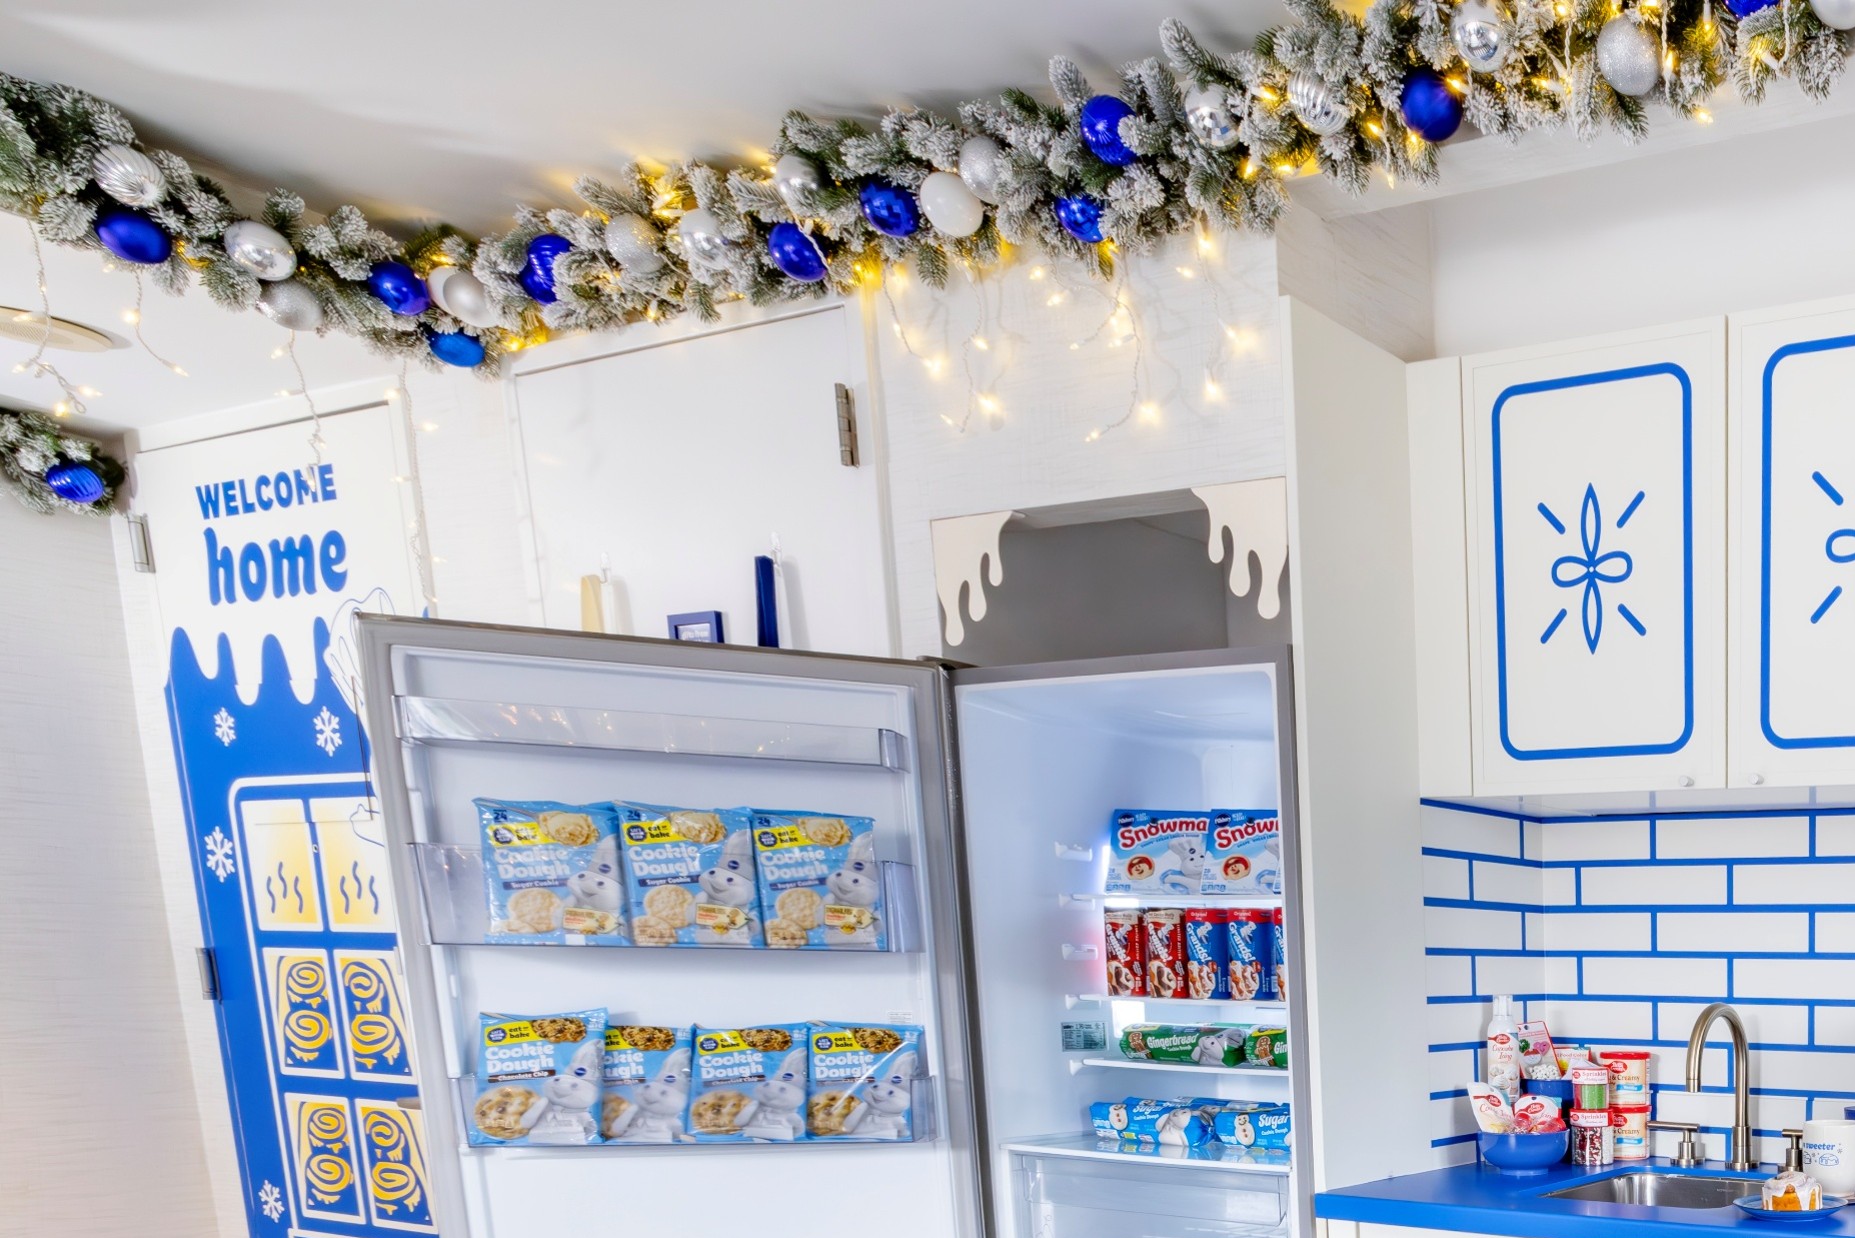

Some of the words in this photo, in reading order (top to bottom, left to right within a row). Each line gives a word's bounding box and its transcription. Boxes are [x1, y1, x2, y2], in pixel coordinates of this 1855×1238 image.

[195, 463, 338, 520] WELCOME
[202, 526, 349, 606] home
[1119, 818, 1208, 849] Snowma
[494, 845, 569, 864] Cookie
[629, 843, 700, 862] Cookie
[761, 846, 826, 866] Cookie
[497, 860, 571, 880] Dough
[632, 859, 701, 878] Dough
[764, 862, 829, 881] Dough
[1229, 921, 1256, 962] Grands!
[485, 1042, 555, 1061] Cookie
[1146, 1034, 1199, 1050] Gingerbread
[487, 1056, 555, 1074] Dough
[603, 1050, 645, 1065] okie
[699, 1050, 764, 1068] Cookie
[813, 1051, 875, 1067] Cookie
[604, 1062, 645, 1079] ugh
[701, 1062, 764, 1080] Dough
[815, 1063, 874, 1079] Dough
[1258, 1113, 1290, 1129] Sugar
[1806, 1142, 1836, 1150] sweeter
